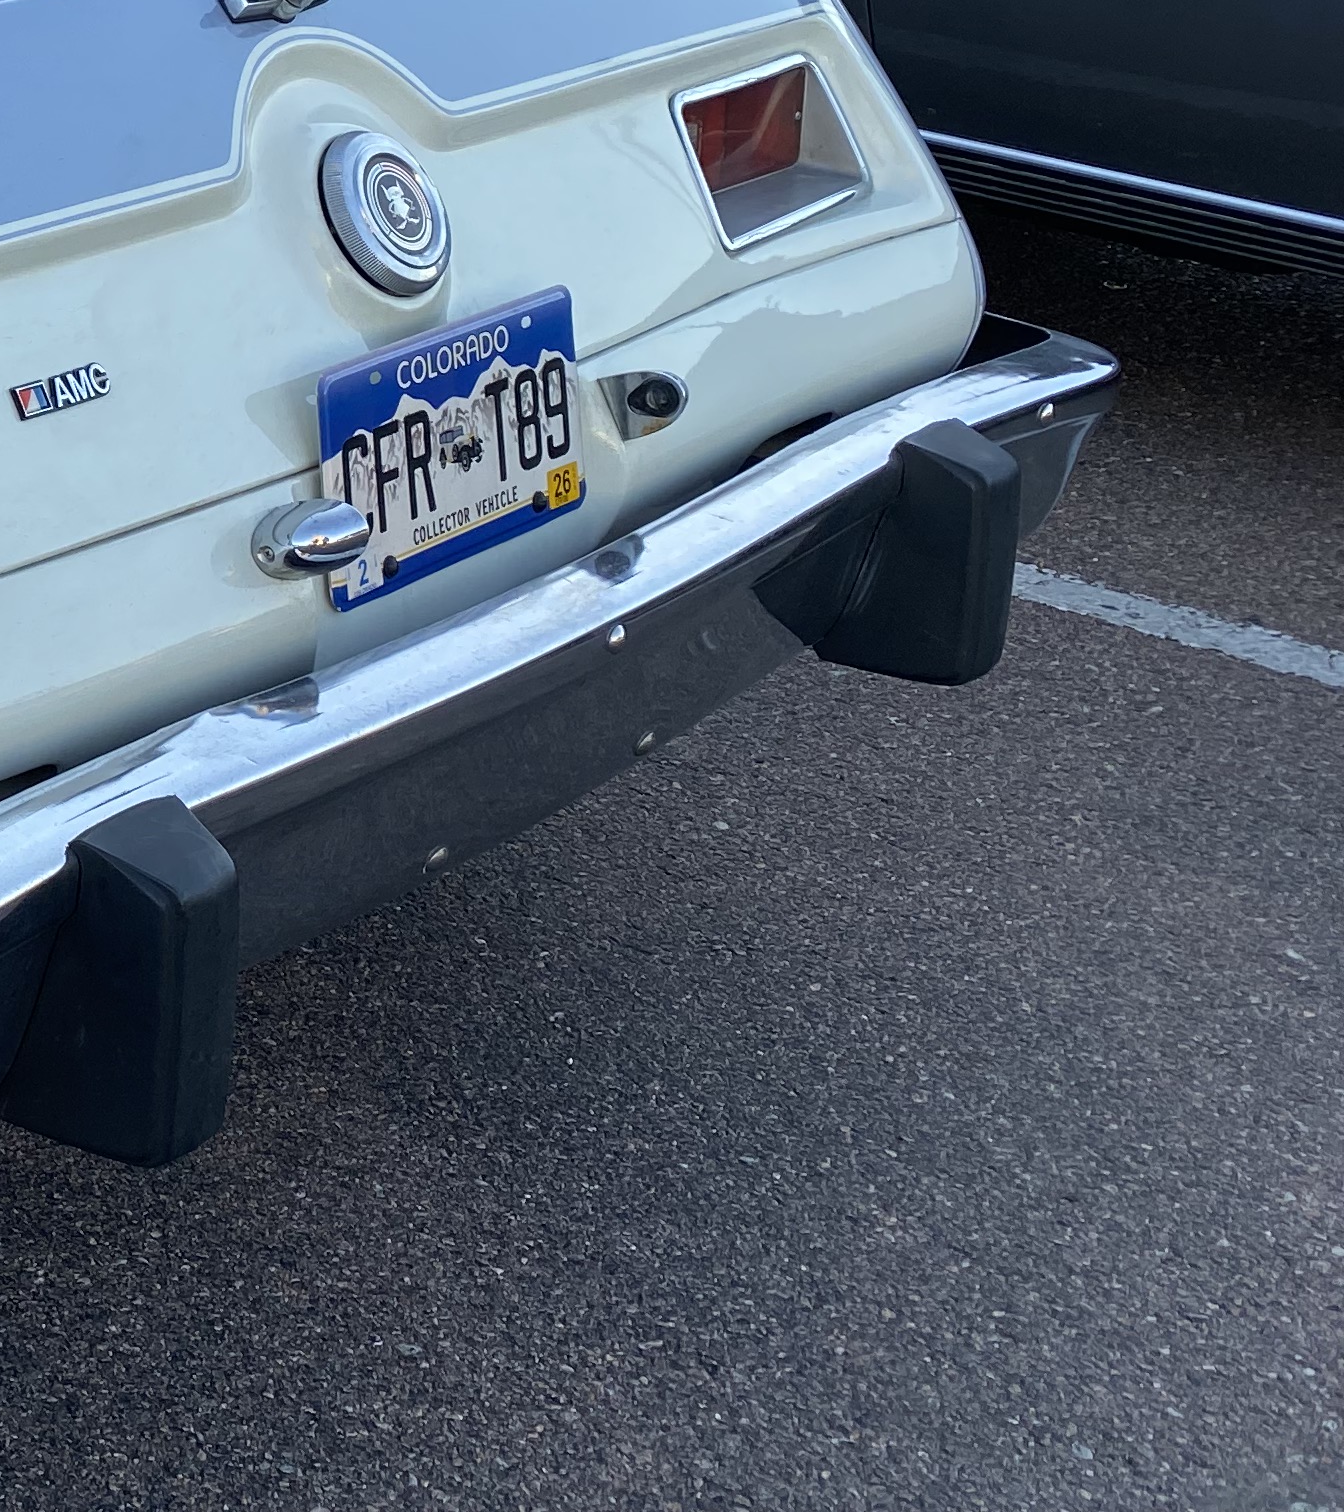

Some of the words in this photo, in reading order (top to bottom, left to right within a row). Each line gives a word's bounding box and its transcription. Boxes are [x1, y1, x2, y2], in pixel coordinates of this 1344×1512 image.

[396, 325, 510, 389] COLORADO
[50, 362, 111, 408] AMC
[341, 409, 437, 536] CFR
[484, 357, 571, 482] T89
[552, 469, 572, 498] 26
[413, 507, 471, 546] COLLECTOR
[475, 485, 519, 518] VEHICLE
[357, 559, 370, 587] 2
